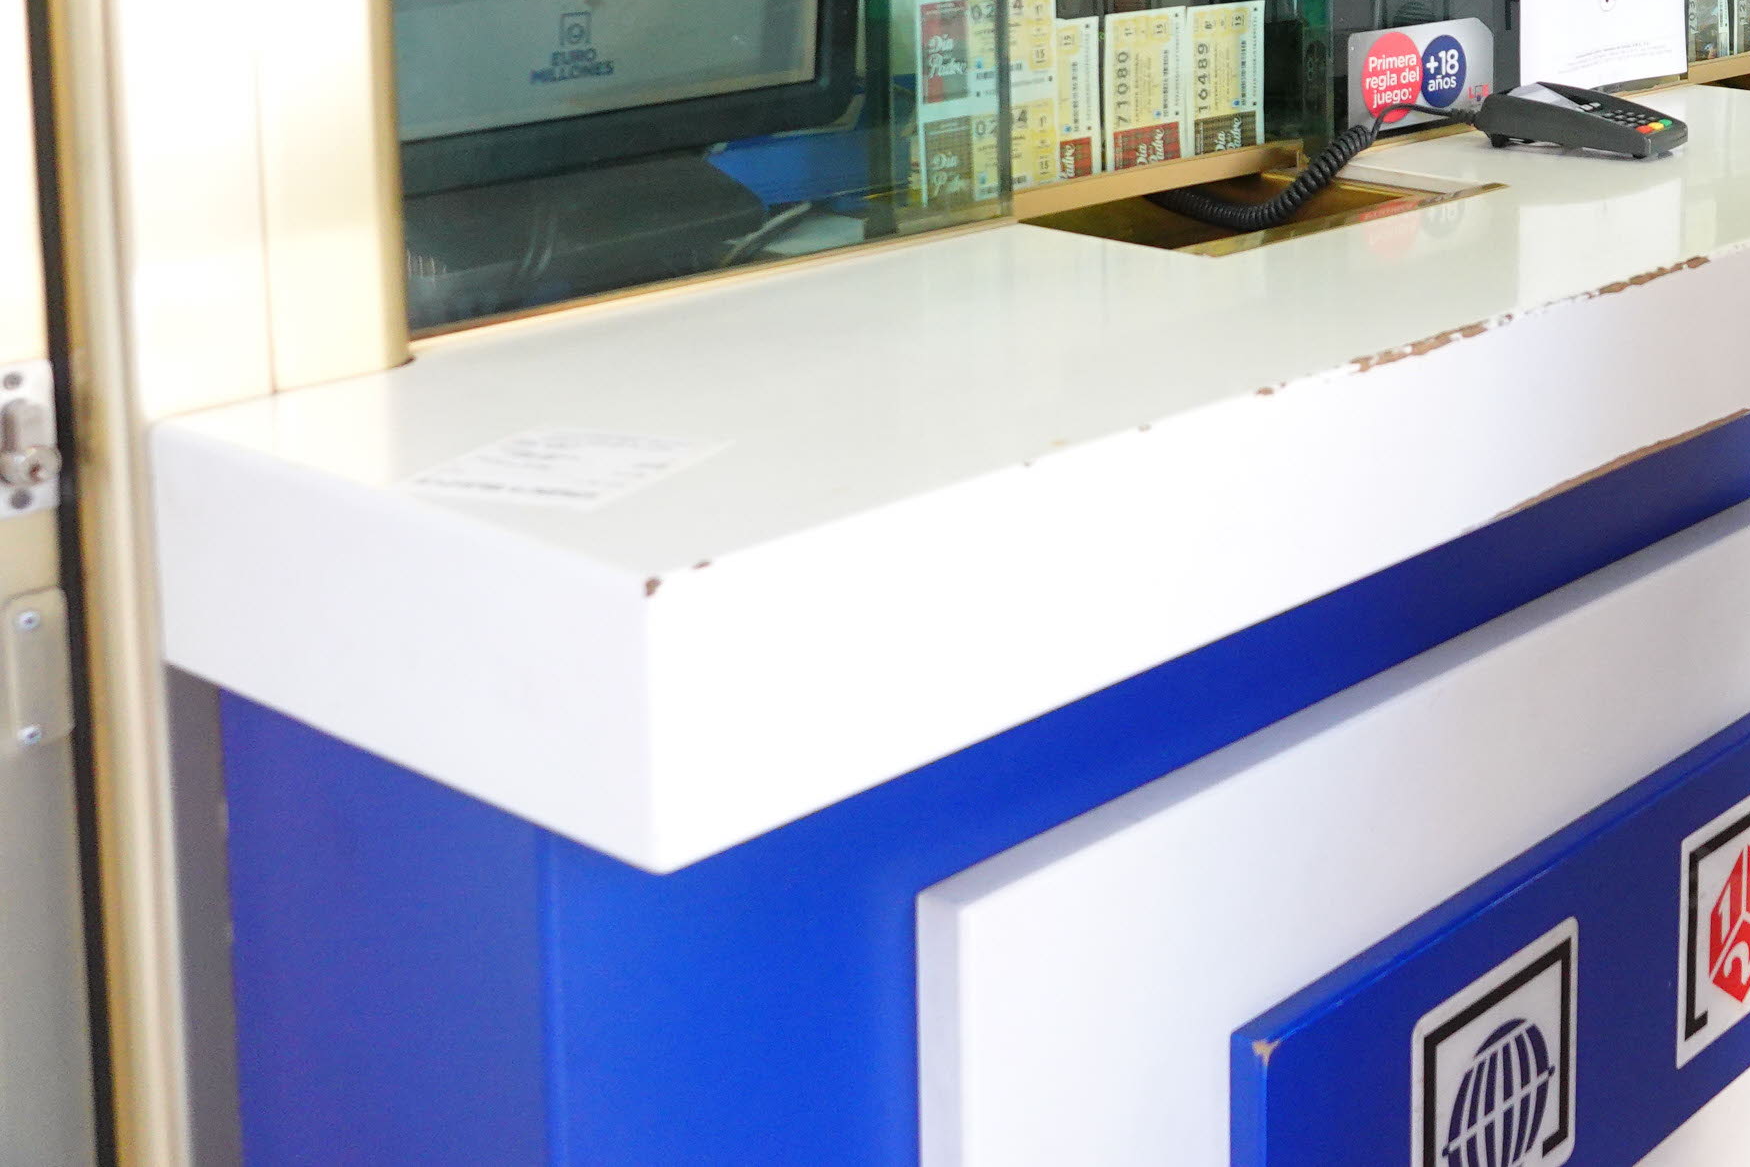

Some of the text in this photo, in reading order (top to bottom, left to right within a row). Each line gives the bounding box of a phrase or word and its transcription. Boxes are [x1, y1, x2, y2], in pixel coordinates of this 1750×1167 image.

[1368, 53, 1417, 72] Primera
[1426, 48, 1459, 75] +18
[1116, 51, 1129, 125] 71080
[1197, 43, 1210, 113] 16489
[1365, 66, 1420, 89] regla del
[1428, 74, 1457, 91] años
[1372, 87, 1412, 108] juego:
